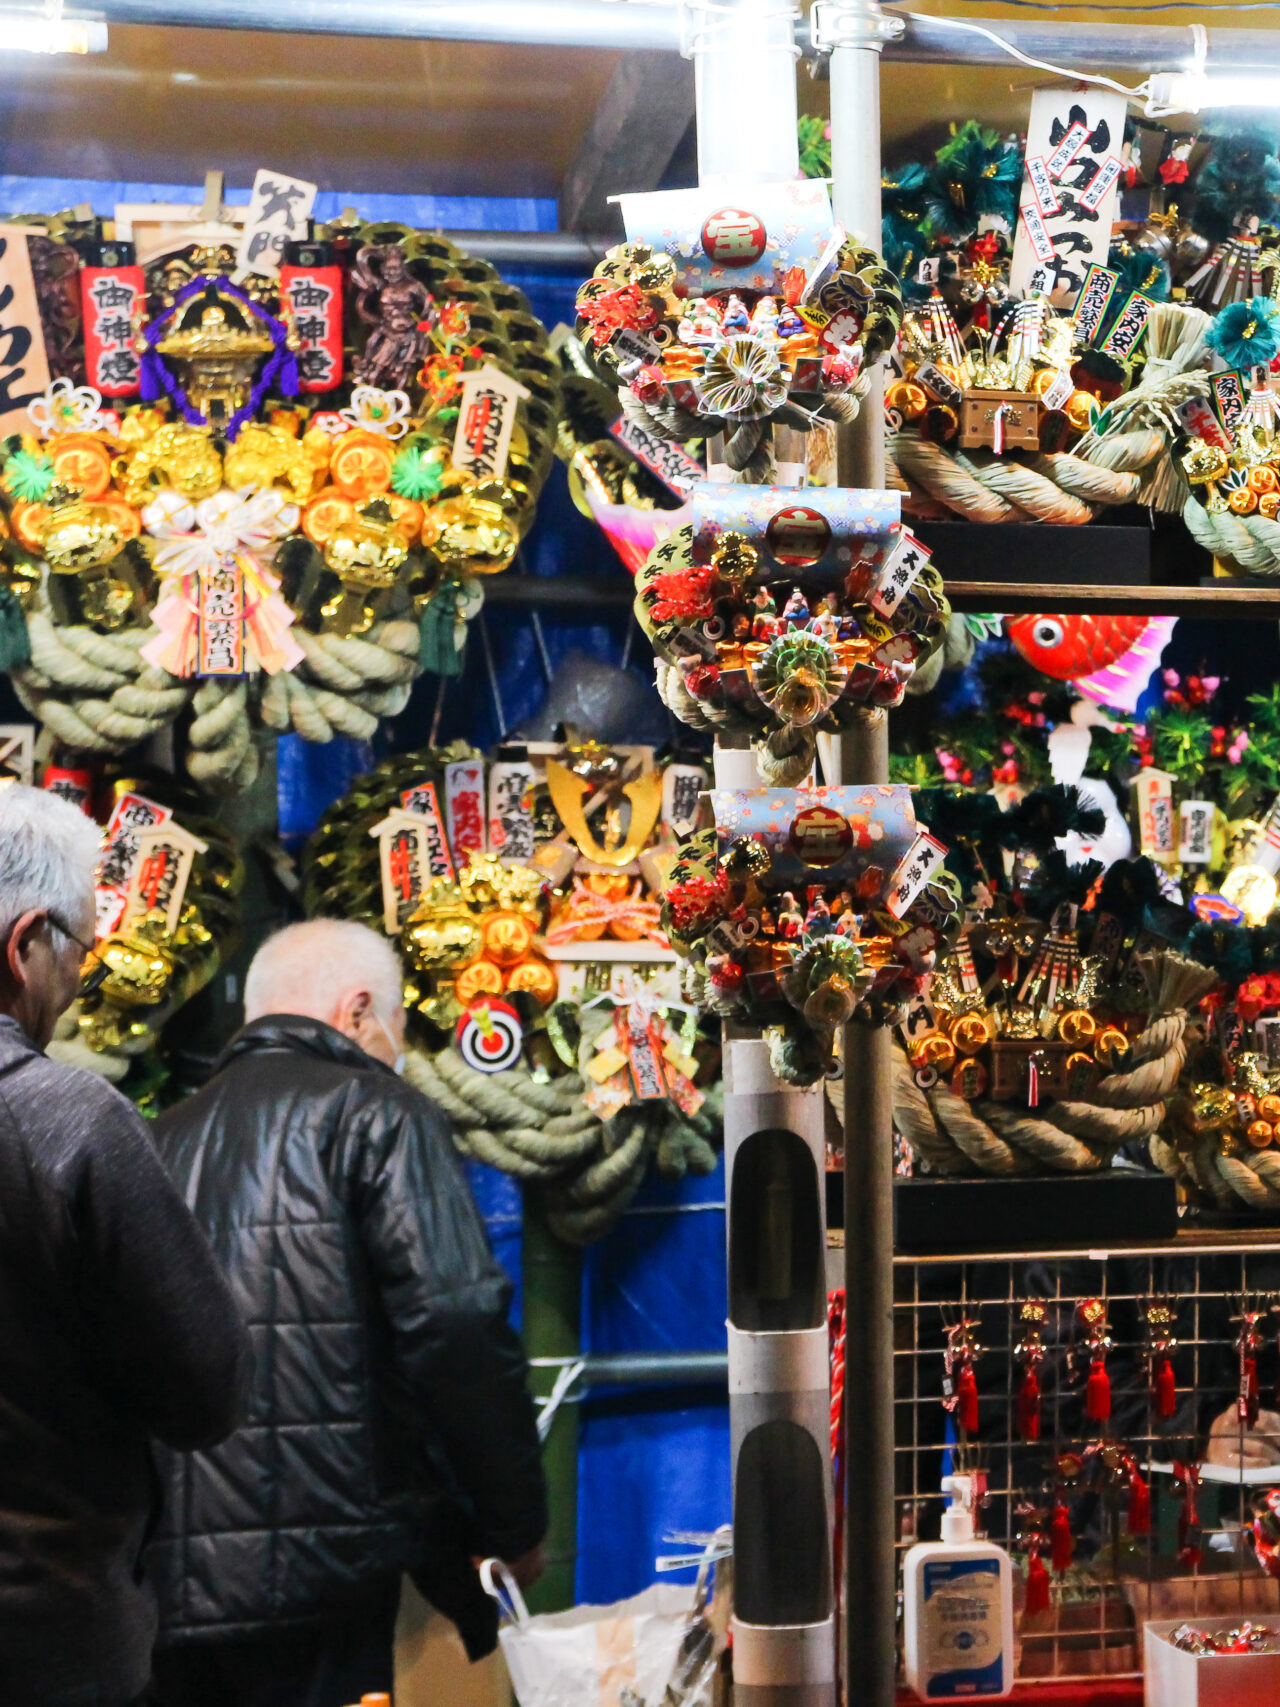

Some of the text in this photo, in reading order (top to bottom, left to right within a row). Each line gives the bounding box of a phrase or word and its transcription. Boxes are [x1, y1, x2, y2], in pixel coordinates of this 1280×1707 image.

[705, 210, 760, 259] 宝
[1109, 298, 1149, 356] 家内安
